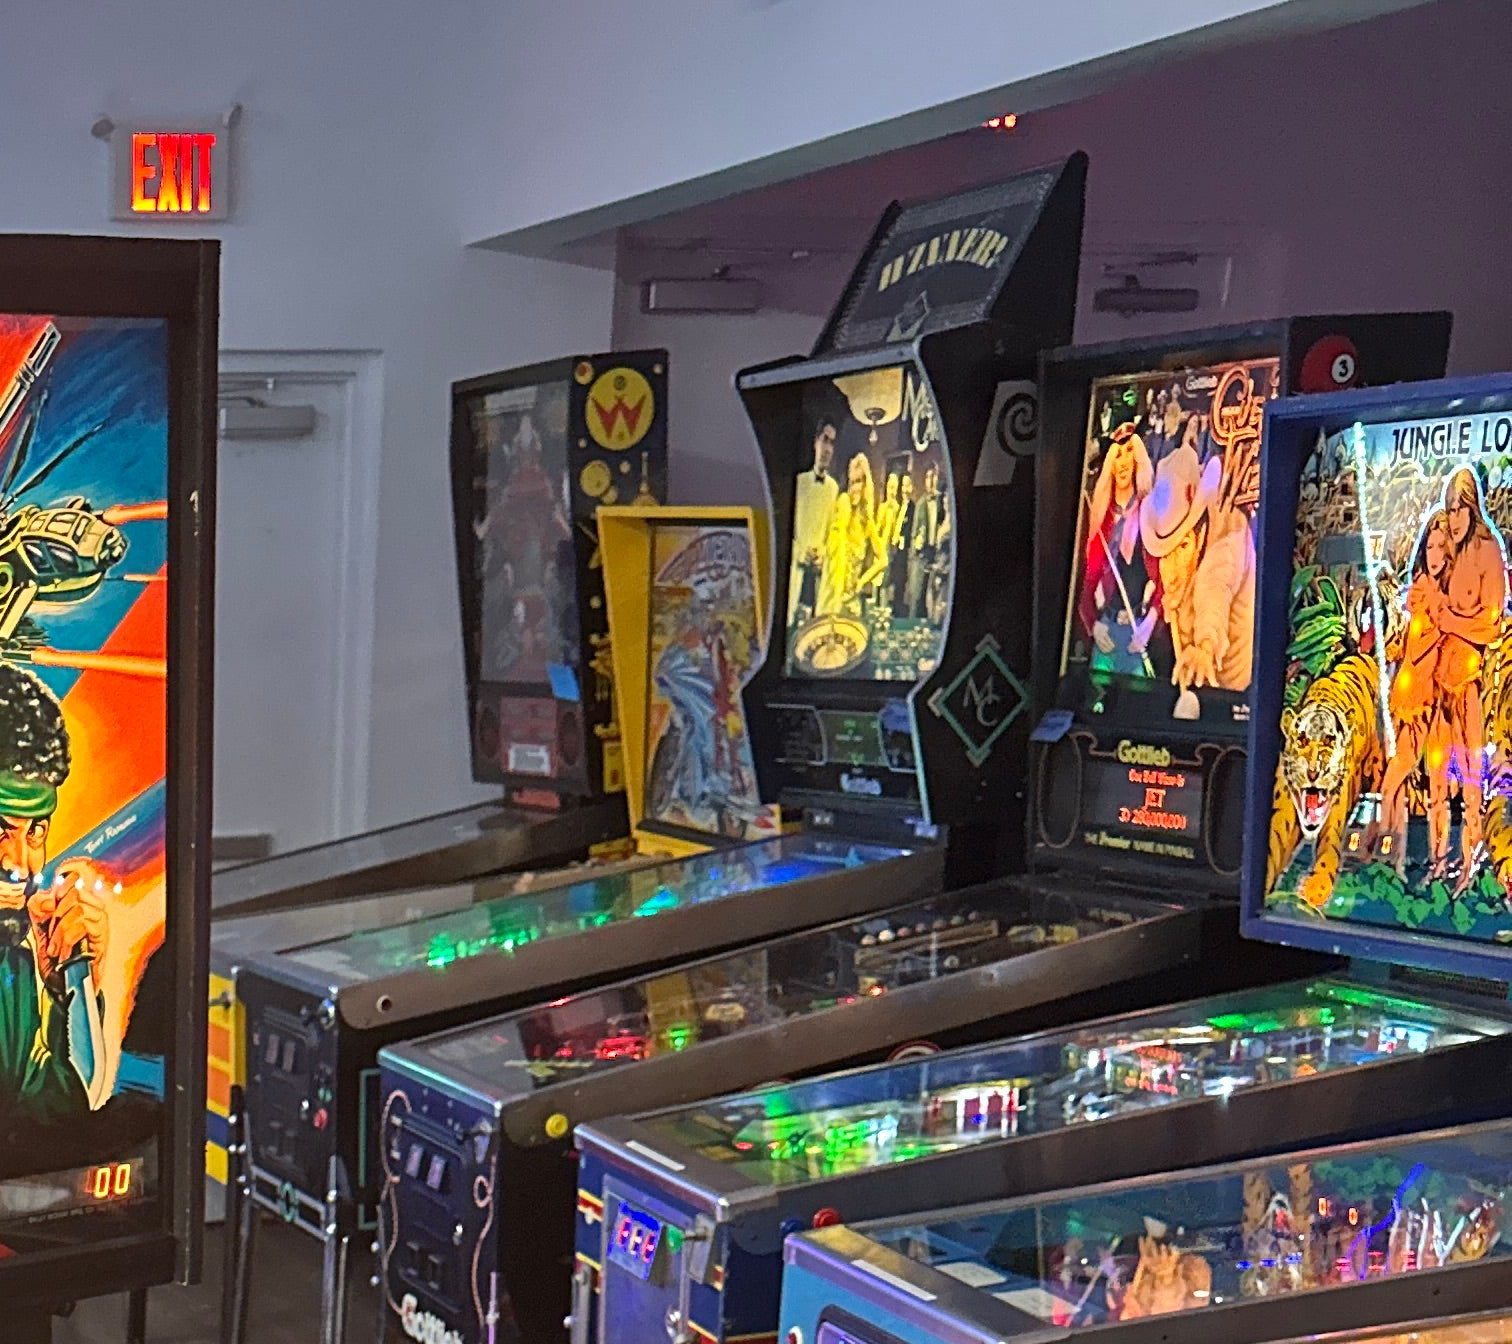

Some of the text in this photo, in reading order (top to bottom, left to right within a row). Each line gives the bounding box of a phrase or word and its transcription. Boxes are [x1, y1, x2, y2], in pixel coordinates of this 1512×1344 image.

[132, 132, 216, 213] EXIT
[1338, 359, 1350, 377] 3
[1390, 415, 1512, 463] JUNGLE LO
[1117, 739, 1171, 768] Gottlieb
